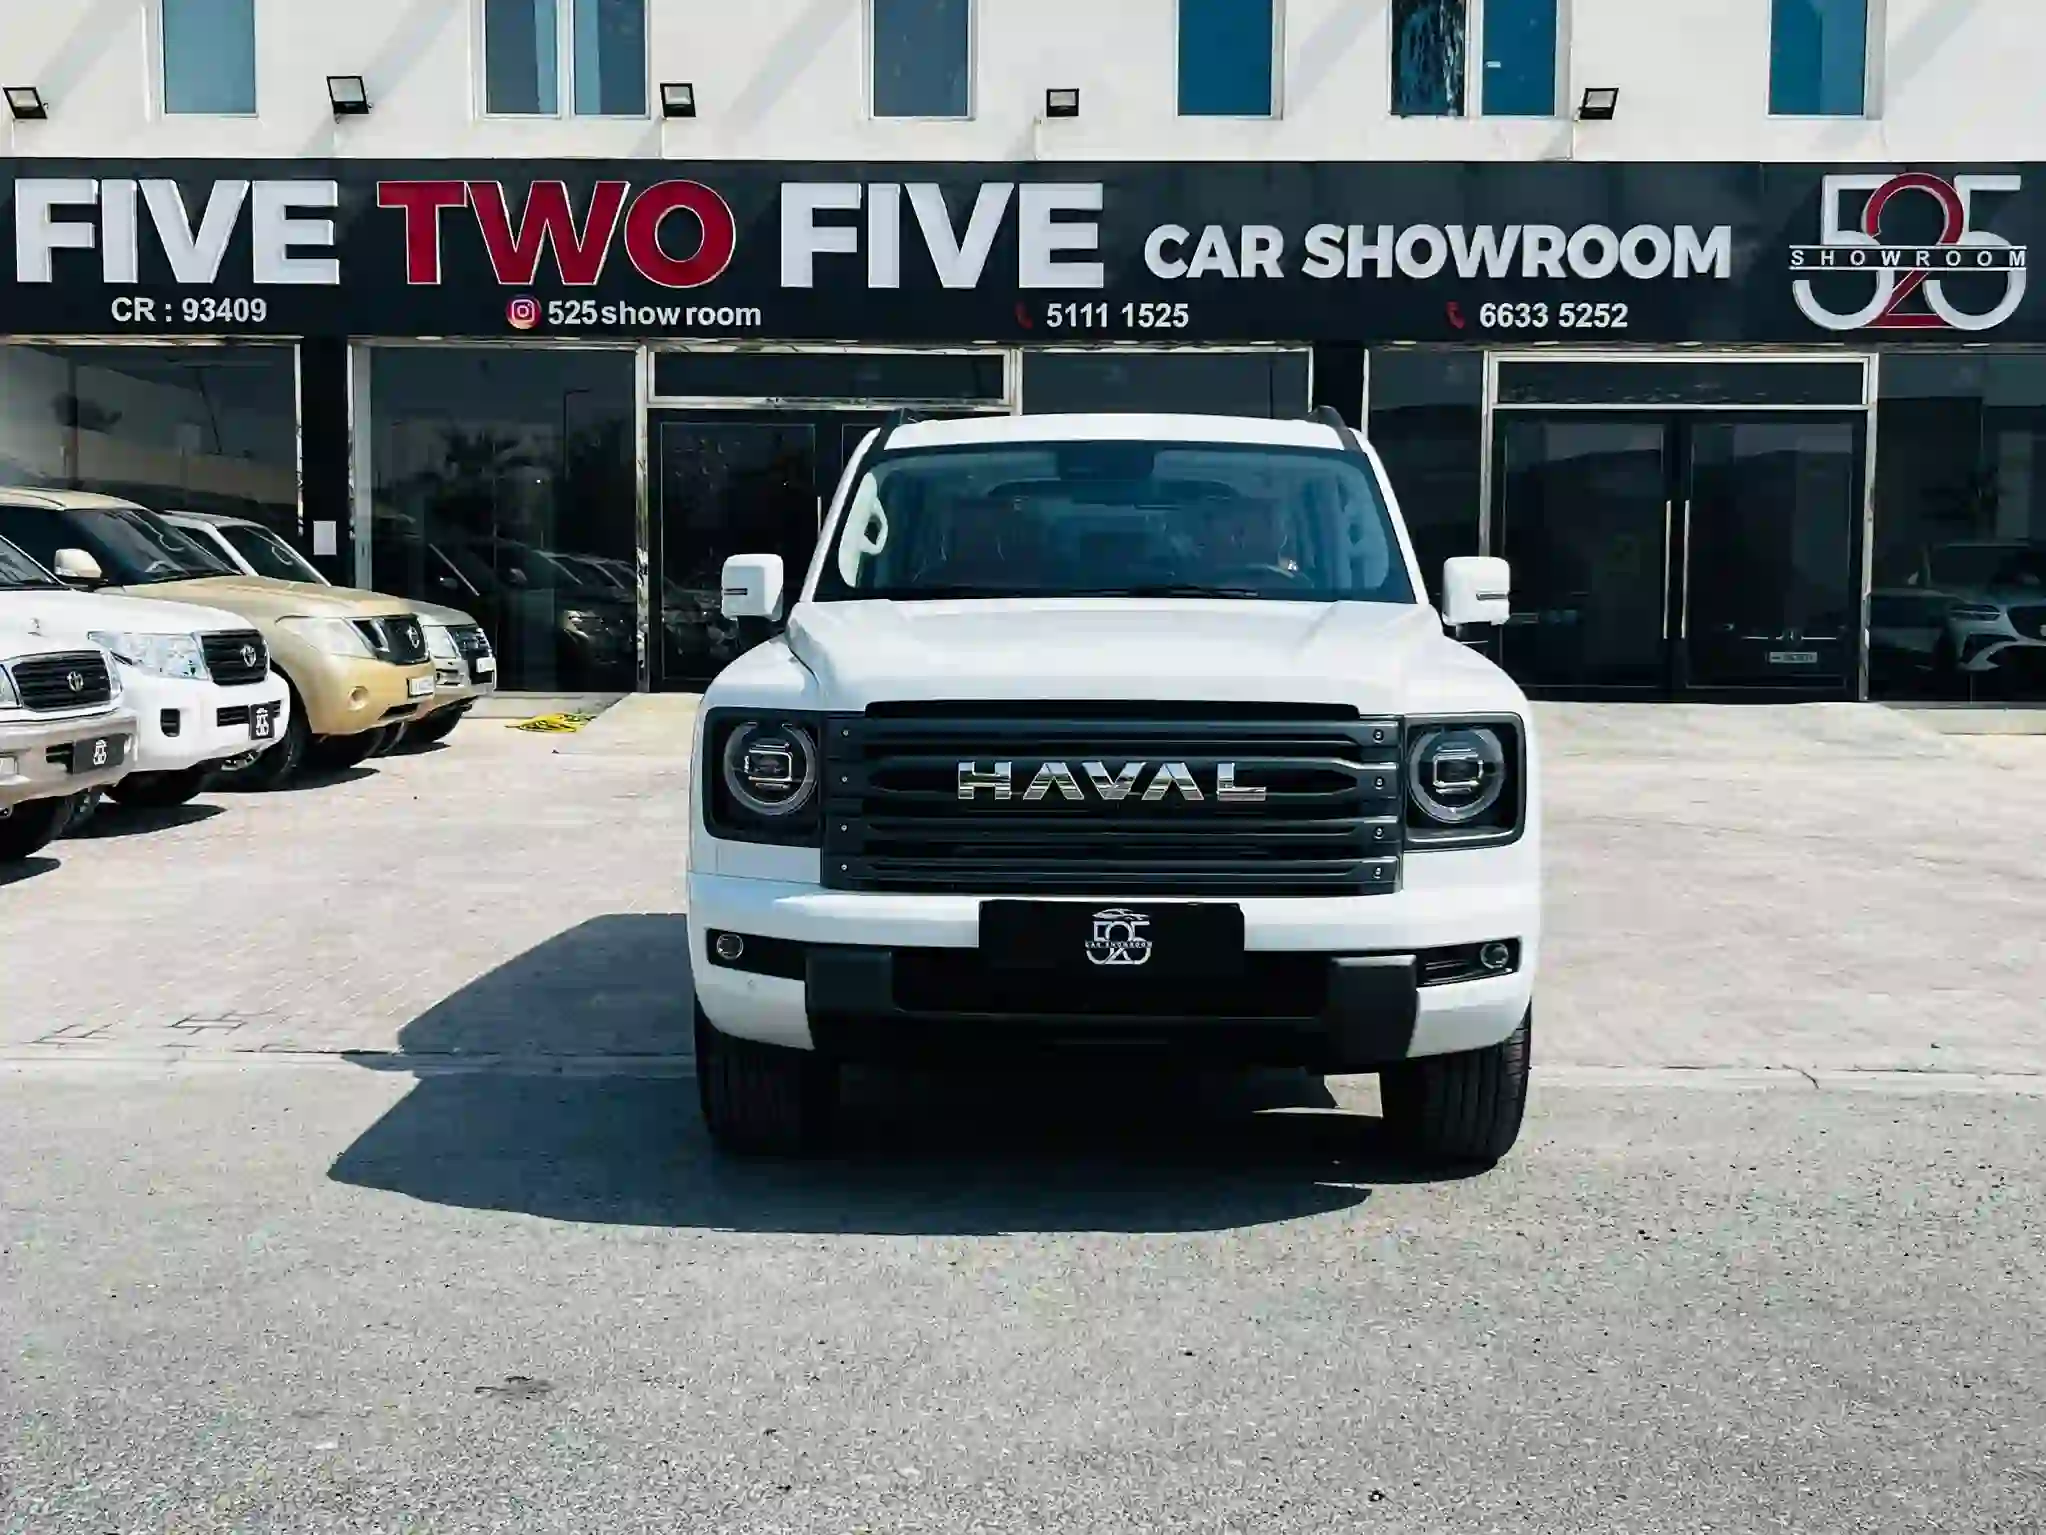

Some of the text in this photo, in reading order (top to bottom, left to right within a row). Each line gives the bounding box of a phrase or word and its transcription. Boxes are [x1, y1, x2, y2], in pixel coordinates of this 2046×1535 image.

[14, 178, 1732, 289] FIVE TWO FIVE CAR SHOWROOM
[1791, 249, 2027, 267] SHOWROOM
[1792, 172, 2027, 331] 525
[111, 296, 157, 323] CR
[182, 297, 267, 323] 93409
[1046, 302, 1189, 328] 5111 1525
[1479, 302, 1629, 328] 6633 5252
[957, 761, 1267, 801] HAVAL
